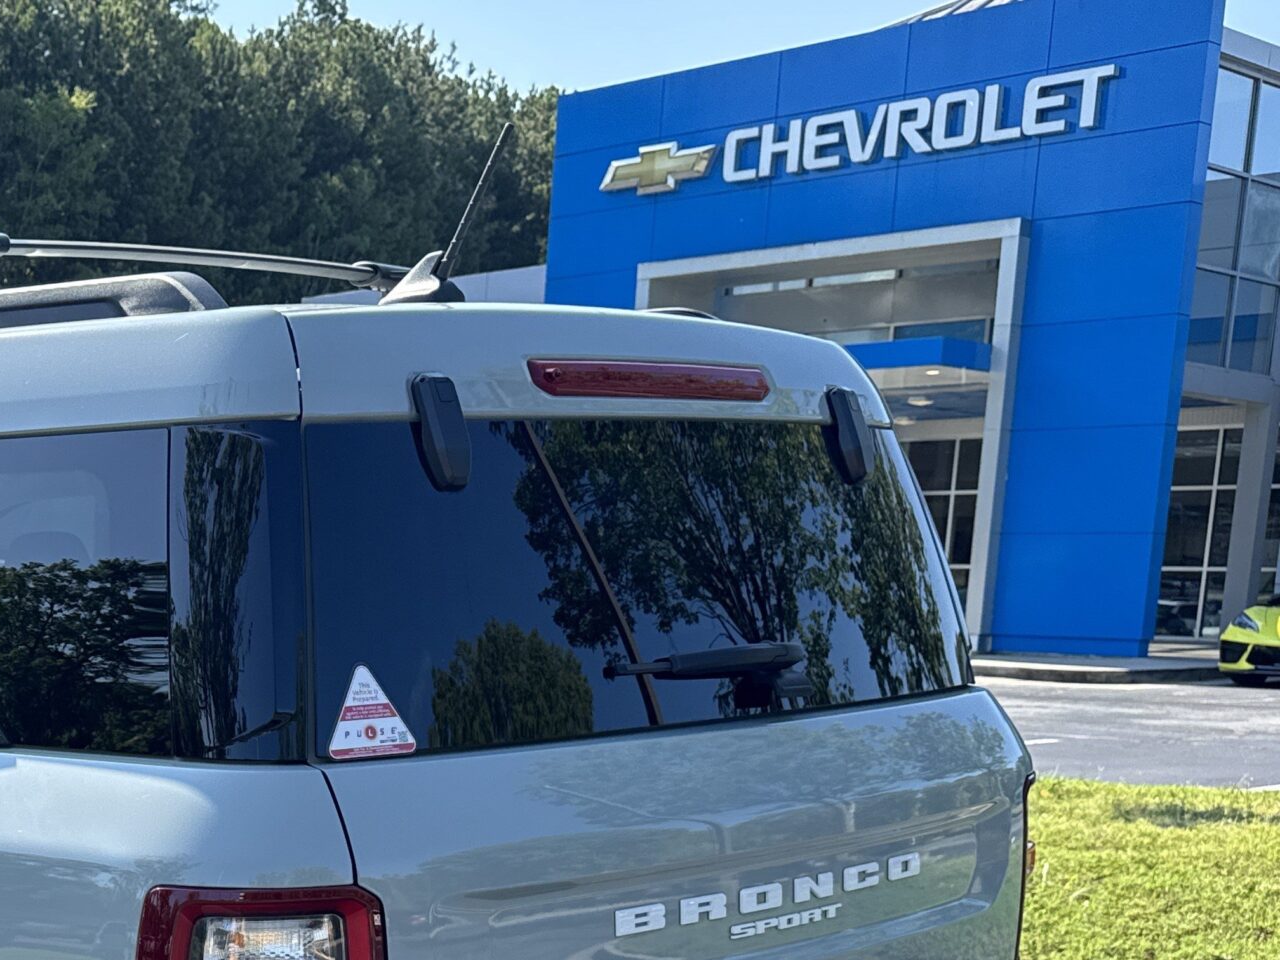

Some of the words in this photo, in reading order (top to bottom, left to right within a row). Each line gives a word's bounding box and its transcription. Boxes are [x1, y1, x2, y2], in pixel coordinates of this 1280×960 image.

[723, 64, 1117, 184] CHEVROLET
[344, 726, 397, 740] PULSE
[614, 852, 920, 937] BRONCO
[730, 903, 842, 940] SPORT
